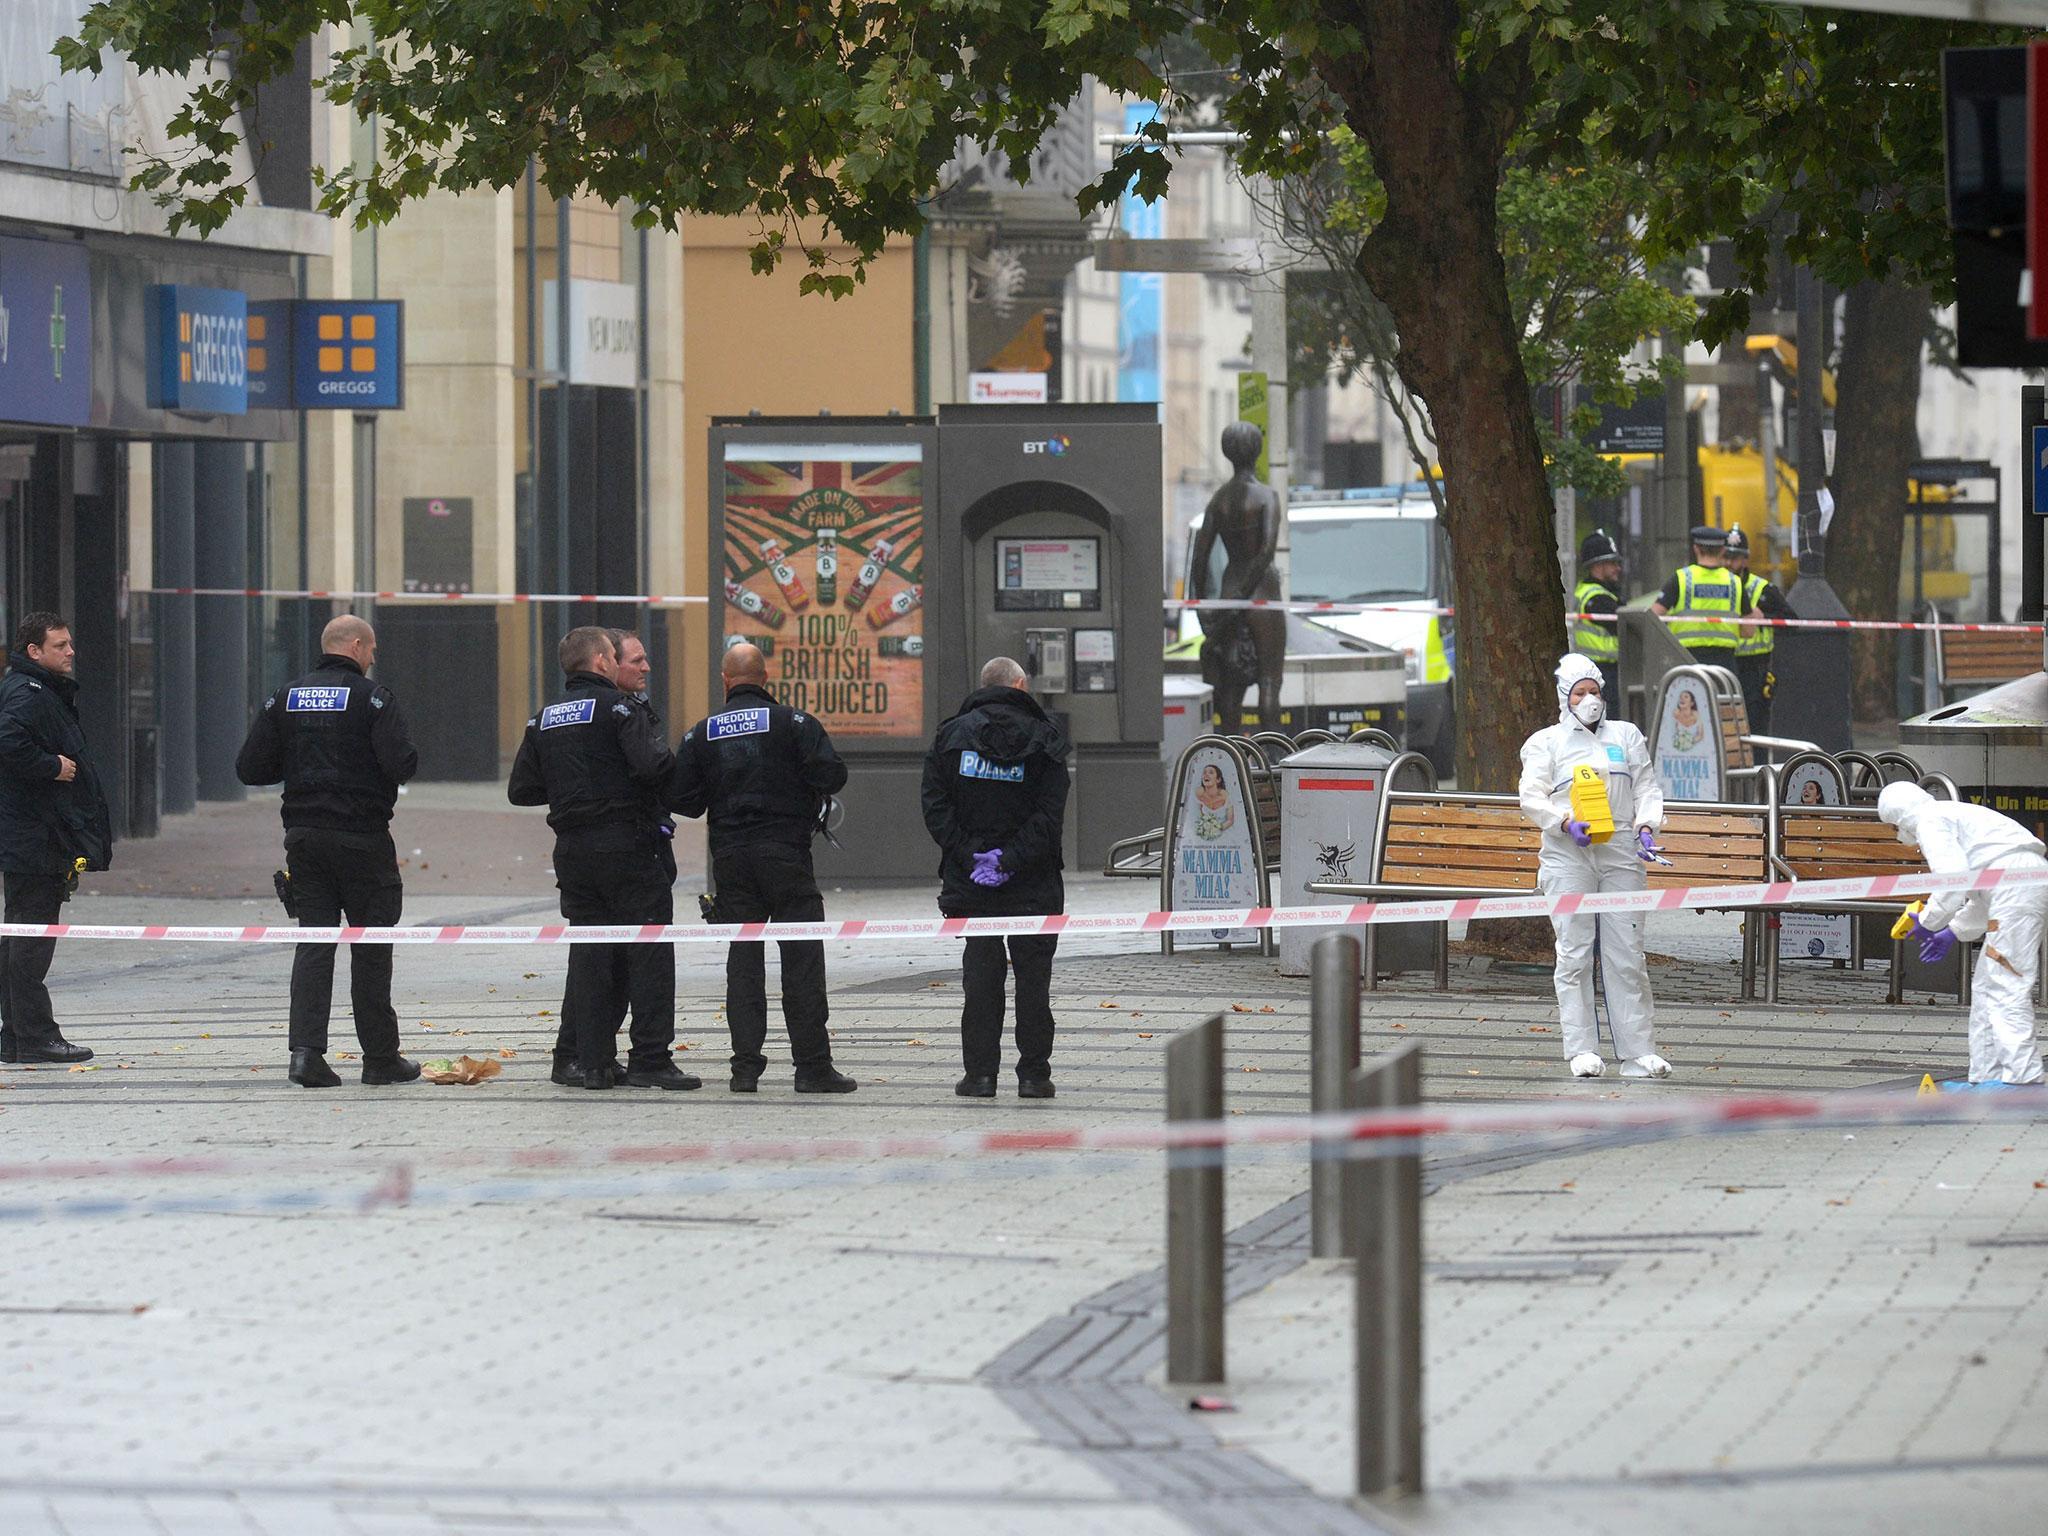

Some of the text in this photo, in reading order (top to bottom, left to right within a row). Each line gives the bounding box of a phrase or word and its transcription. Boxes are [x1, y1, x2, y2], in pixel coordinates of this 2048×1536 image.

[193, 313, 243, 386] GREGGS
[318, 381, 376, 394] GREGGS
[1023, 441, 1046, 453] BT
[789, 490, 865, 521] MADE ON OUR
[808, 511, 845, 527] FARM
[822, 558, 831, 569] B
[778, 567, 787, 578] B
[865, 567, 874, 578] B
[898, 596, 909, 607] B
[797, 614, 858, 647] 100%
[782, 648, 871, 681] BRITISH
[297, 689, 339, 698] HEDDLU
[298, 699, 335, 708] POLICE
[550, 702, 586, 716] HEDDLU
[549, 711, 581, 724] POLICE
[716, 711, 759, 726] HEDDLU
[718, 721, 757, 735] POLICE
[1580, 769, 1591, 780] 6
[1995, 796, 2019, 810] Un
[1182, 849, 1242, 874] MAMMA
[1194, 875, 1230, 899] MIA!
